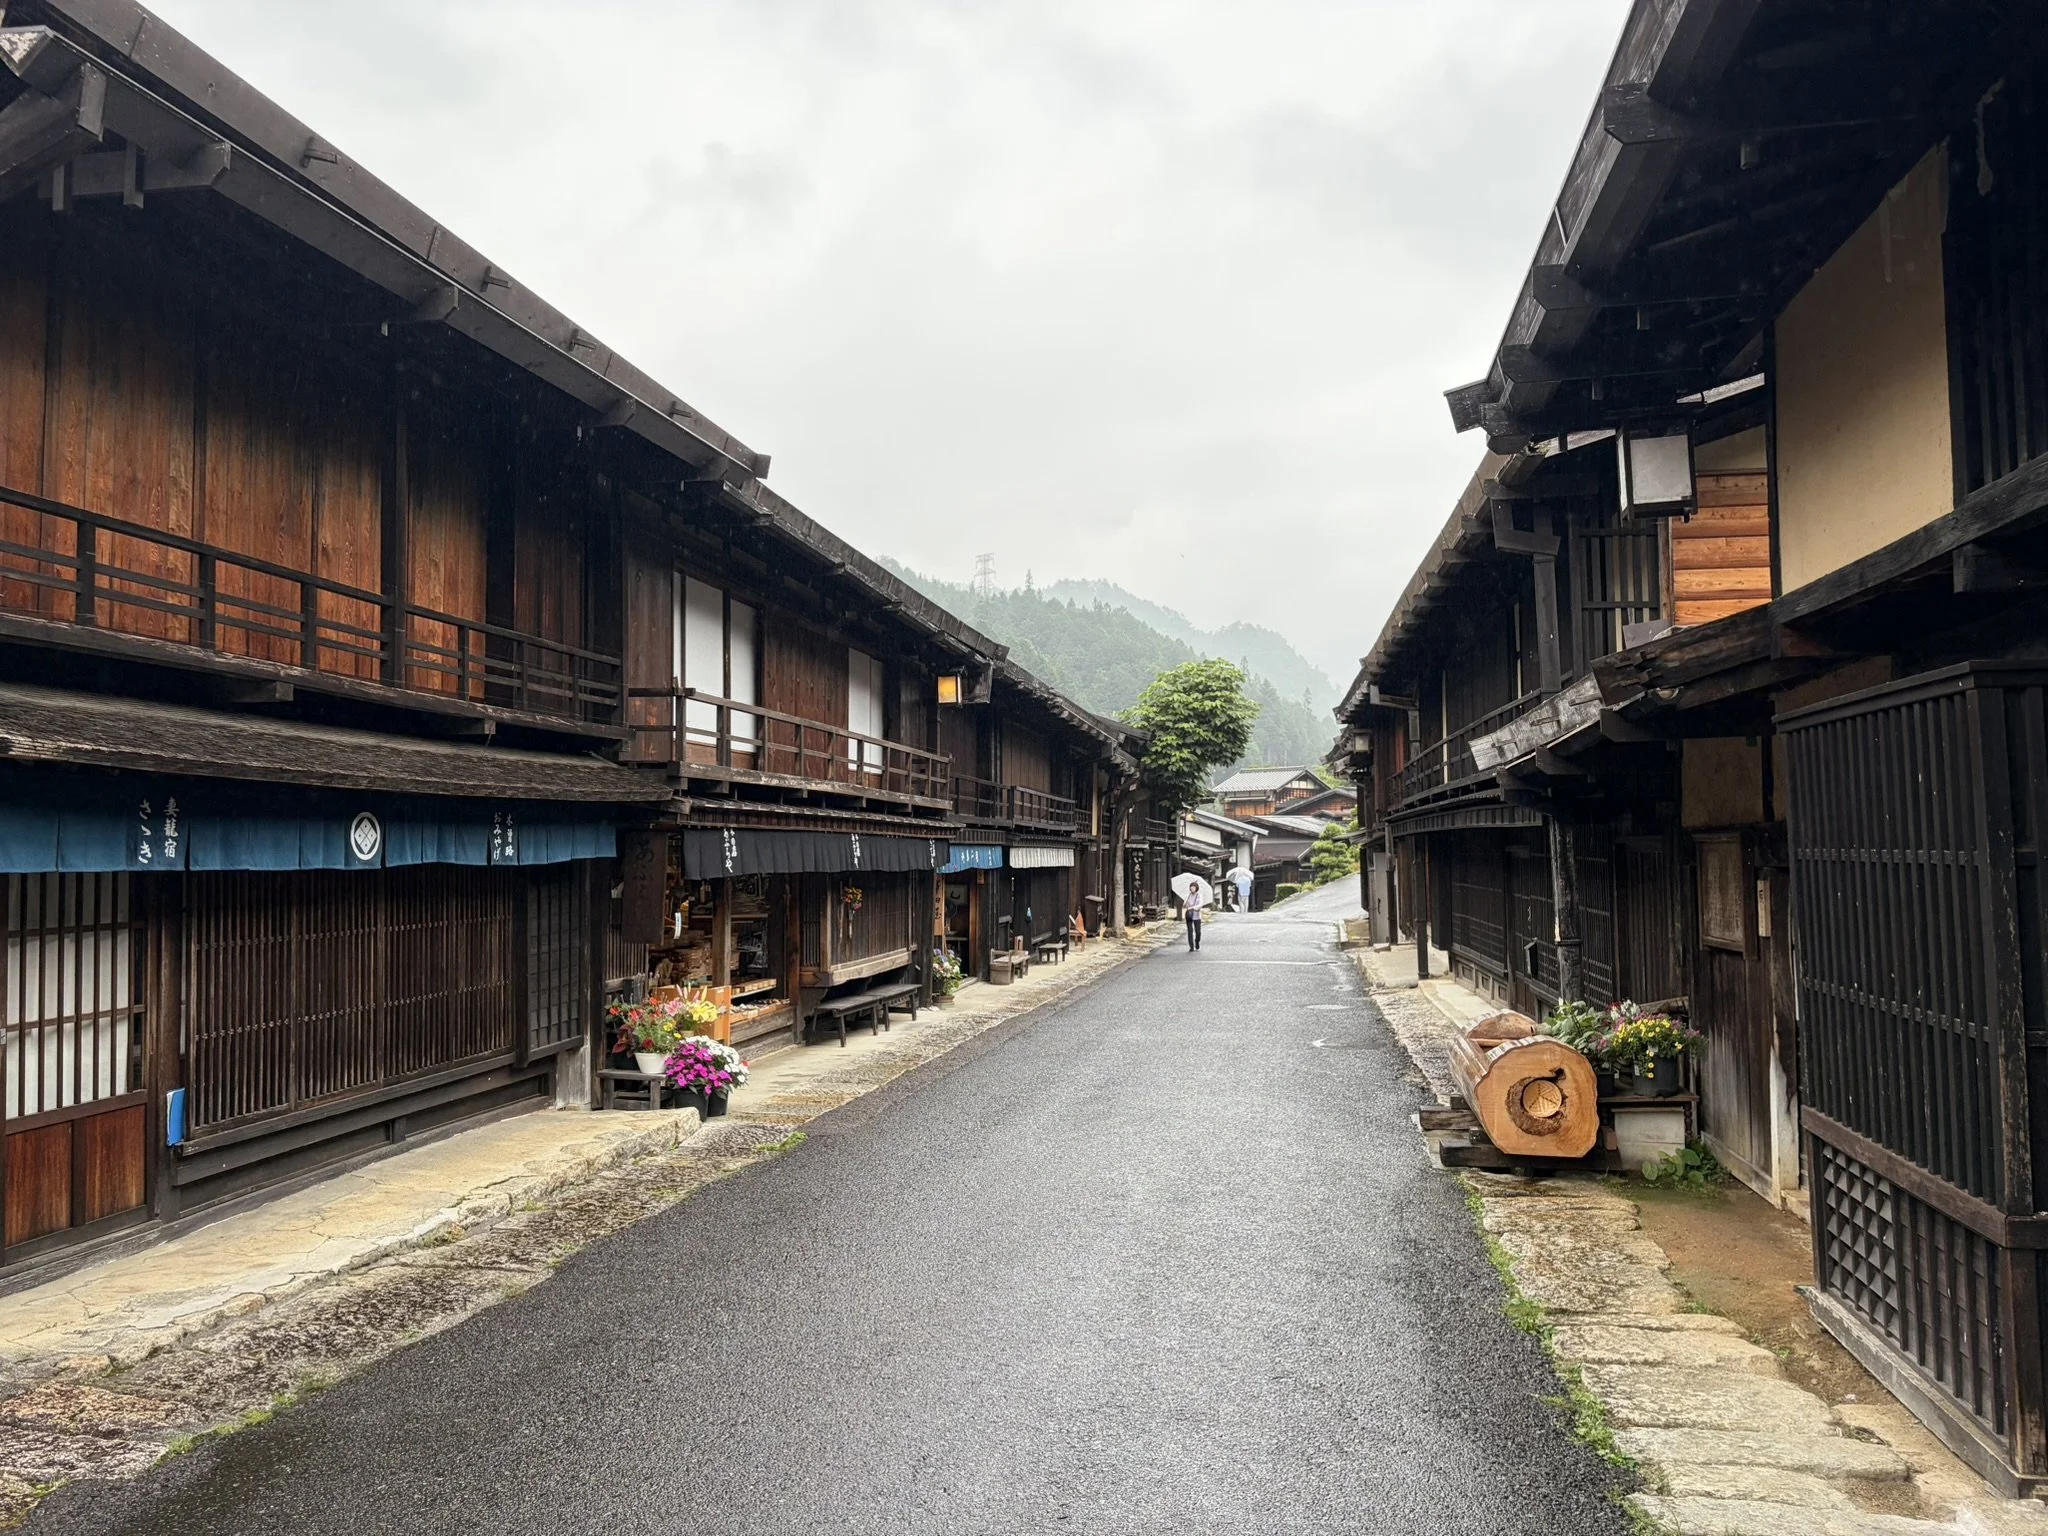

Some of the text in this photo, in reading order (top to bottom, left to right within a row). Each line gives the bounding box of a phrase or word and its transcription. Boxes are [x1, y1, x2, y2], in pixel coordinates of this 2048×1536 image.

[163, 796, 180, 859] 妻籠宿
[493, 811, 502, 861] おみやげ
[505, 813, 515, 857] 木曽路
